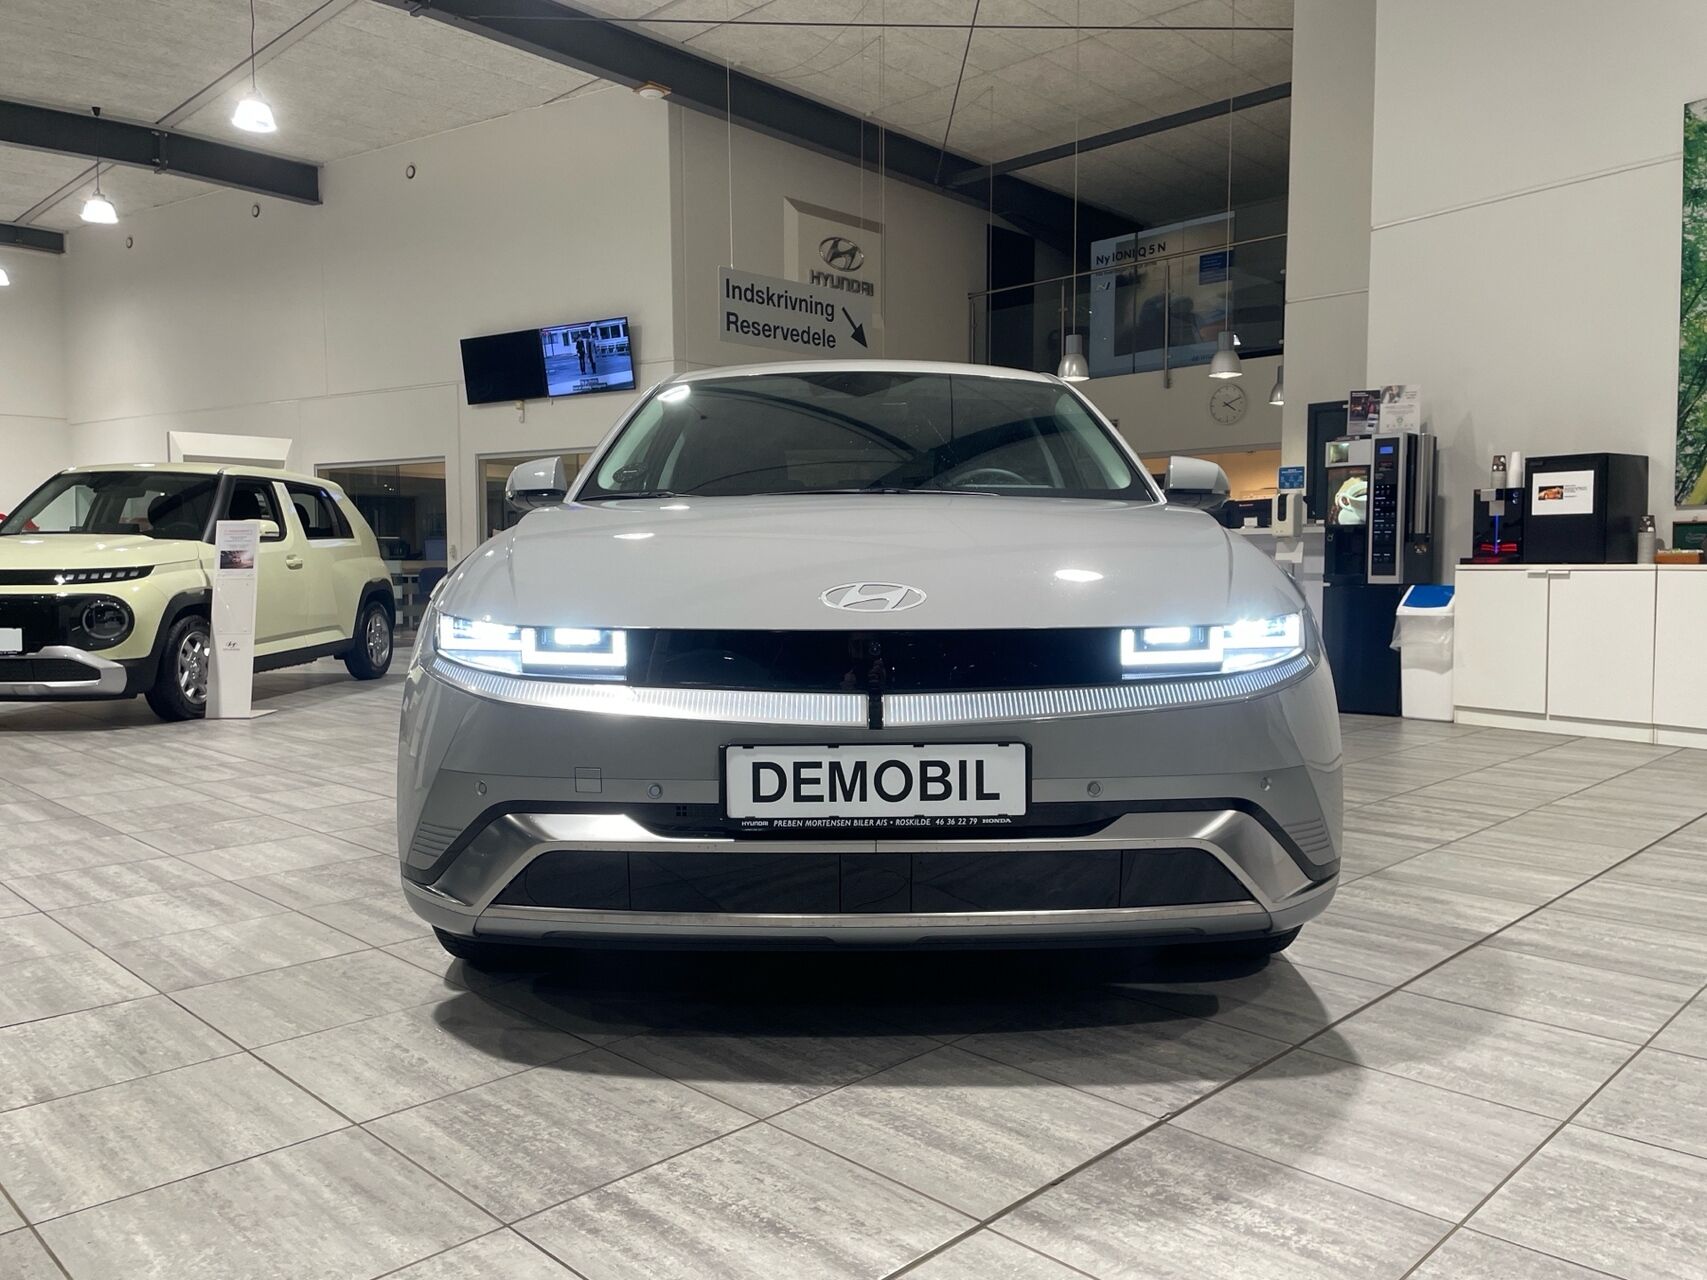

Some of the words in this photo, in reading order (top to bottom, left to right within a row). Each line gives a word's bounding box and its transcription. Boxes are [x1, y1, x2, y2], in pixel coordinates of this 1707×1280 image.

[1096, 255, 1110, 265] Ny
[1148, 244, 1155, 255] 5
[1157, 242, 1166, 253] N
[810, 270, 874, 297] HYUNDAI
[725, 278, 835, 322] Indskrivning
[726, 311, 836, 348] Reservedele
[752, 760, 1001, 803] DEMOBIL
[773, 819, 803, 828] PREBEN
[804, 819, 851, 828] MORTENSEN
[853, 818, 874, 827] BILER
[875, 818, 888, 827] A/S
[895, 818, 931, 827] ROSKILDE
[935, 818, 945, 826] 46
[946, 818, 956, 826] 36
[957, 818, 967, 826] 22
[968, 817, 978, 826] 79
